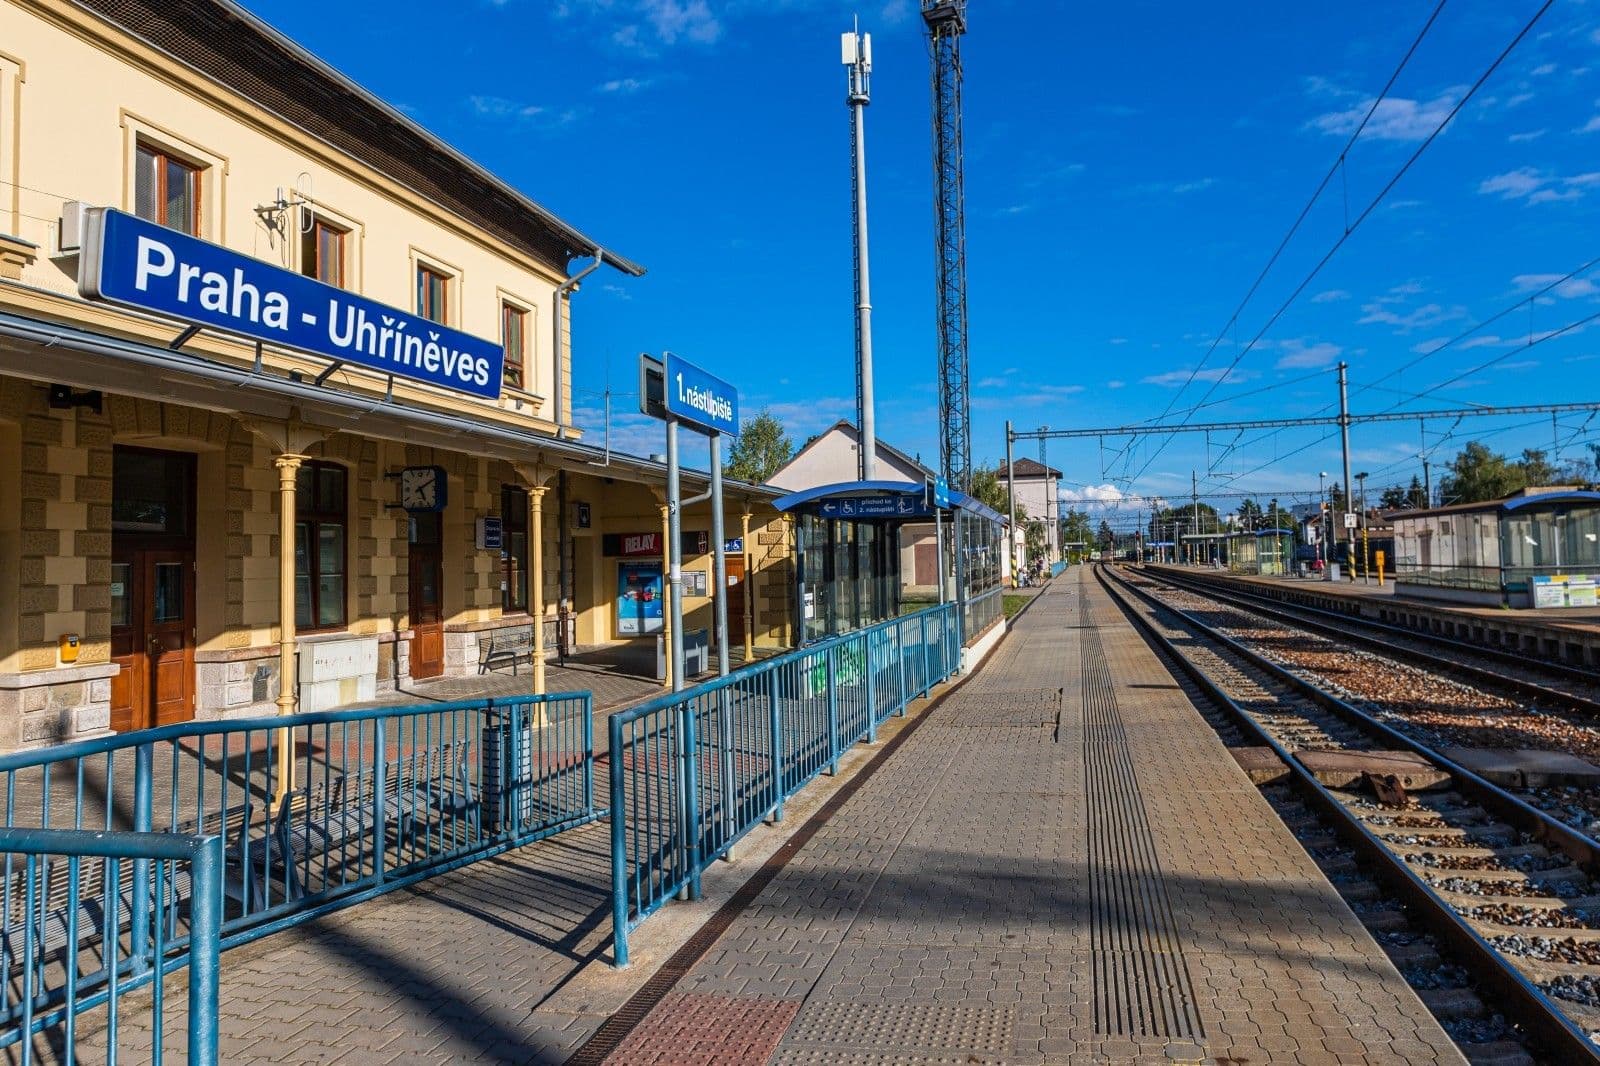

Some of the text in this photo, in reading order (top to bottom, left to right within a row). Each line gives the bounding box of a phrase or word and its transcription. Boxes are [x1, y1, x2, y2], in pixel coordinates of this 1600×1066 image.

[135, 235, 289, 331] Praha
[328, 299, 490, 387] Uhříněves
[624, 533, 655, 553] RELAY
